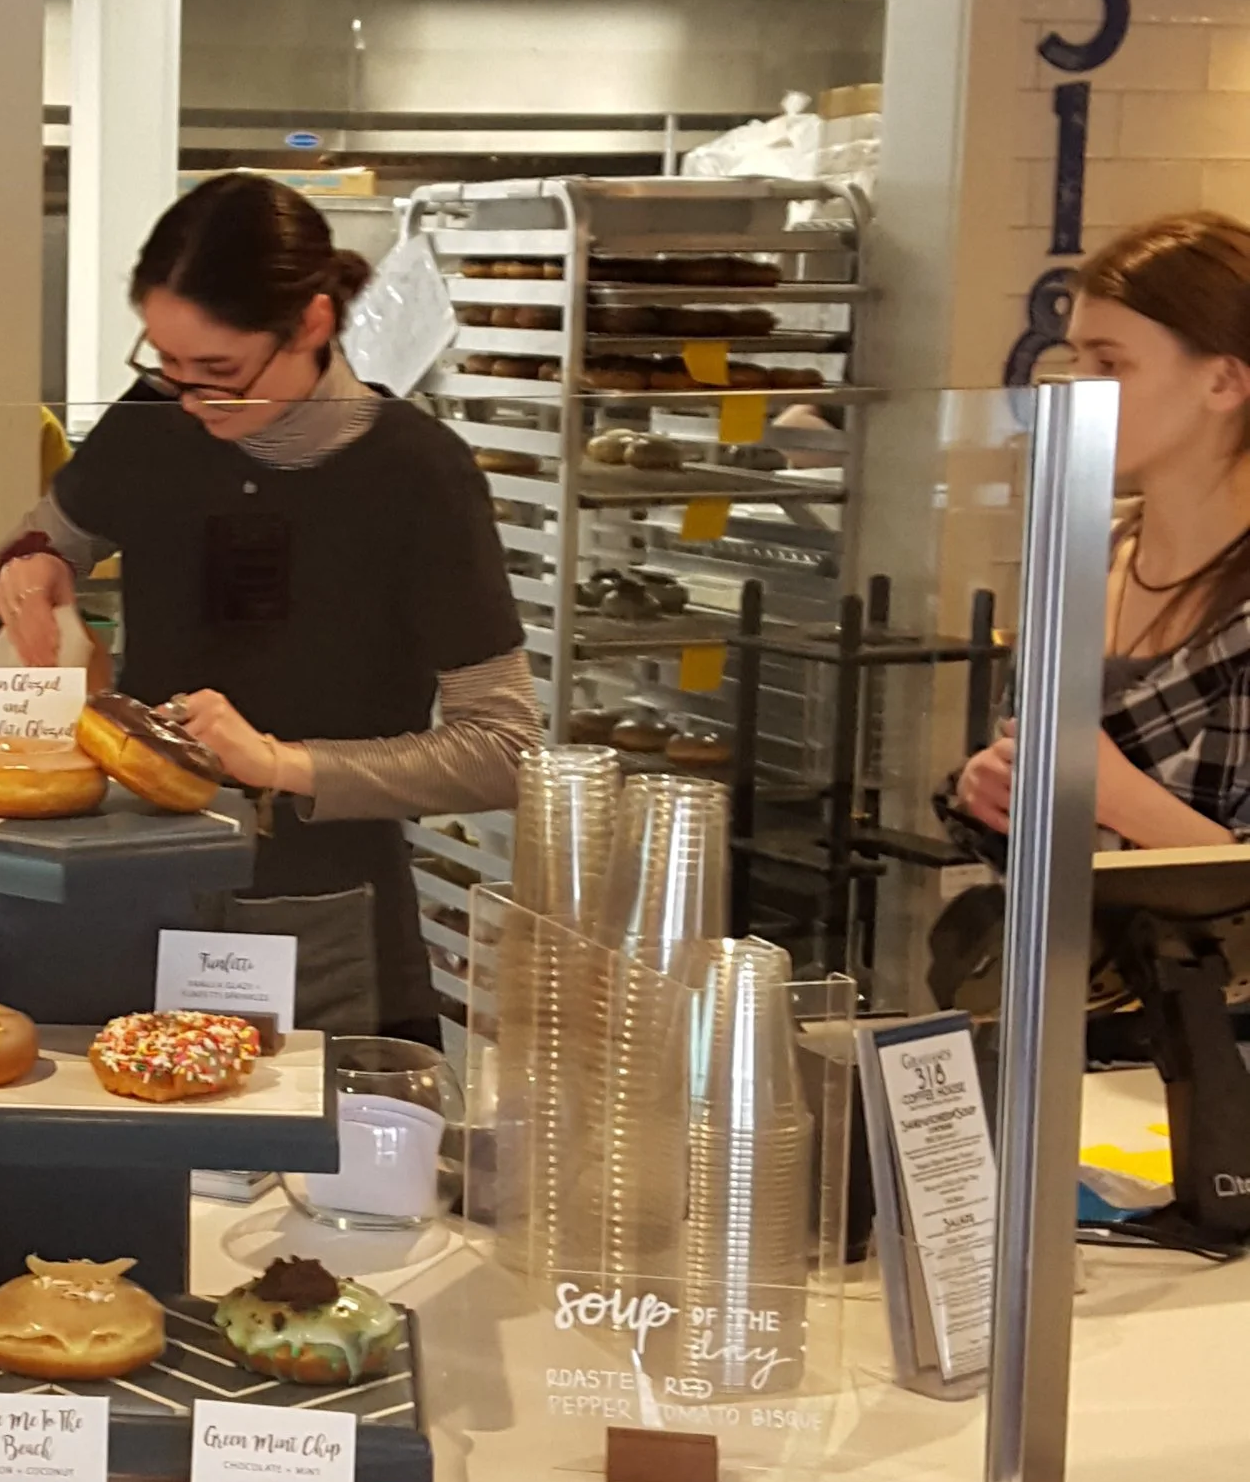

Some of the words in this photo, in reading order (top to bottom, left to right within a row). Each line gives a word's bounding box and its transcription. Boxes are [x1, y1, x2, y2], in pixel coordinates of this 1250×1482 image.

[10, 673, 62, 697] Glazed
[2, 699, 30, 715] and
[199, 951, 255, 973] Funfetti
[555, 1282, 679, 1354] soup
[691, 1307, 718, 1327] OF
[730, 1308, 780, 1333] THE
[689, 1331, 797, 1390] day
[545, 1368, 648, 1391] ROASTE
[664, 1376, 713, 1399] RED
[8, 1412, 39, 1432] Me
[41, 1409, 57, 1431] To
[58, 1409, 85, 1433] The
[547, 1395, 633, 1421] PEPPER
[654, 1403, 740, 1428] OMATO
[751, 1412, 824, 1432] BISQUE
[2, 1434, 54, 1461] Beach
[203, 1425, 248, 1449] Green
[253, 1433, 298, 1454] Mint
[301, 1433, 342, 1462] Chip
